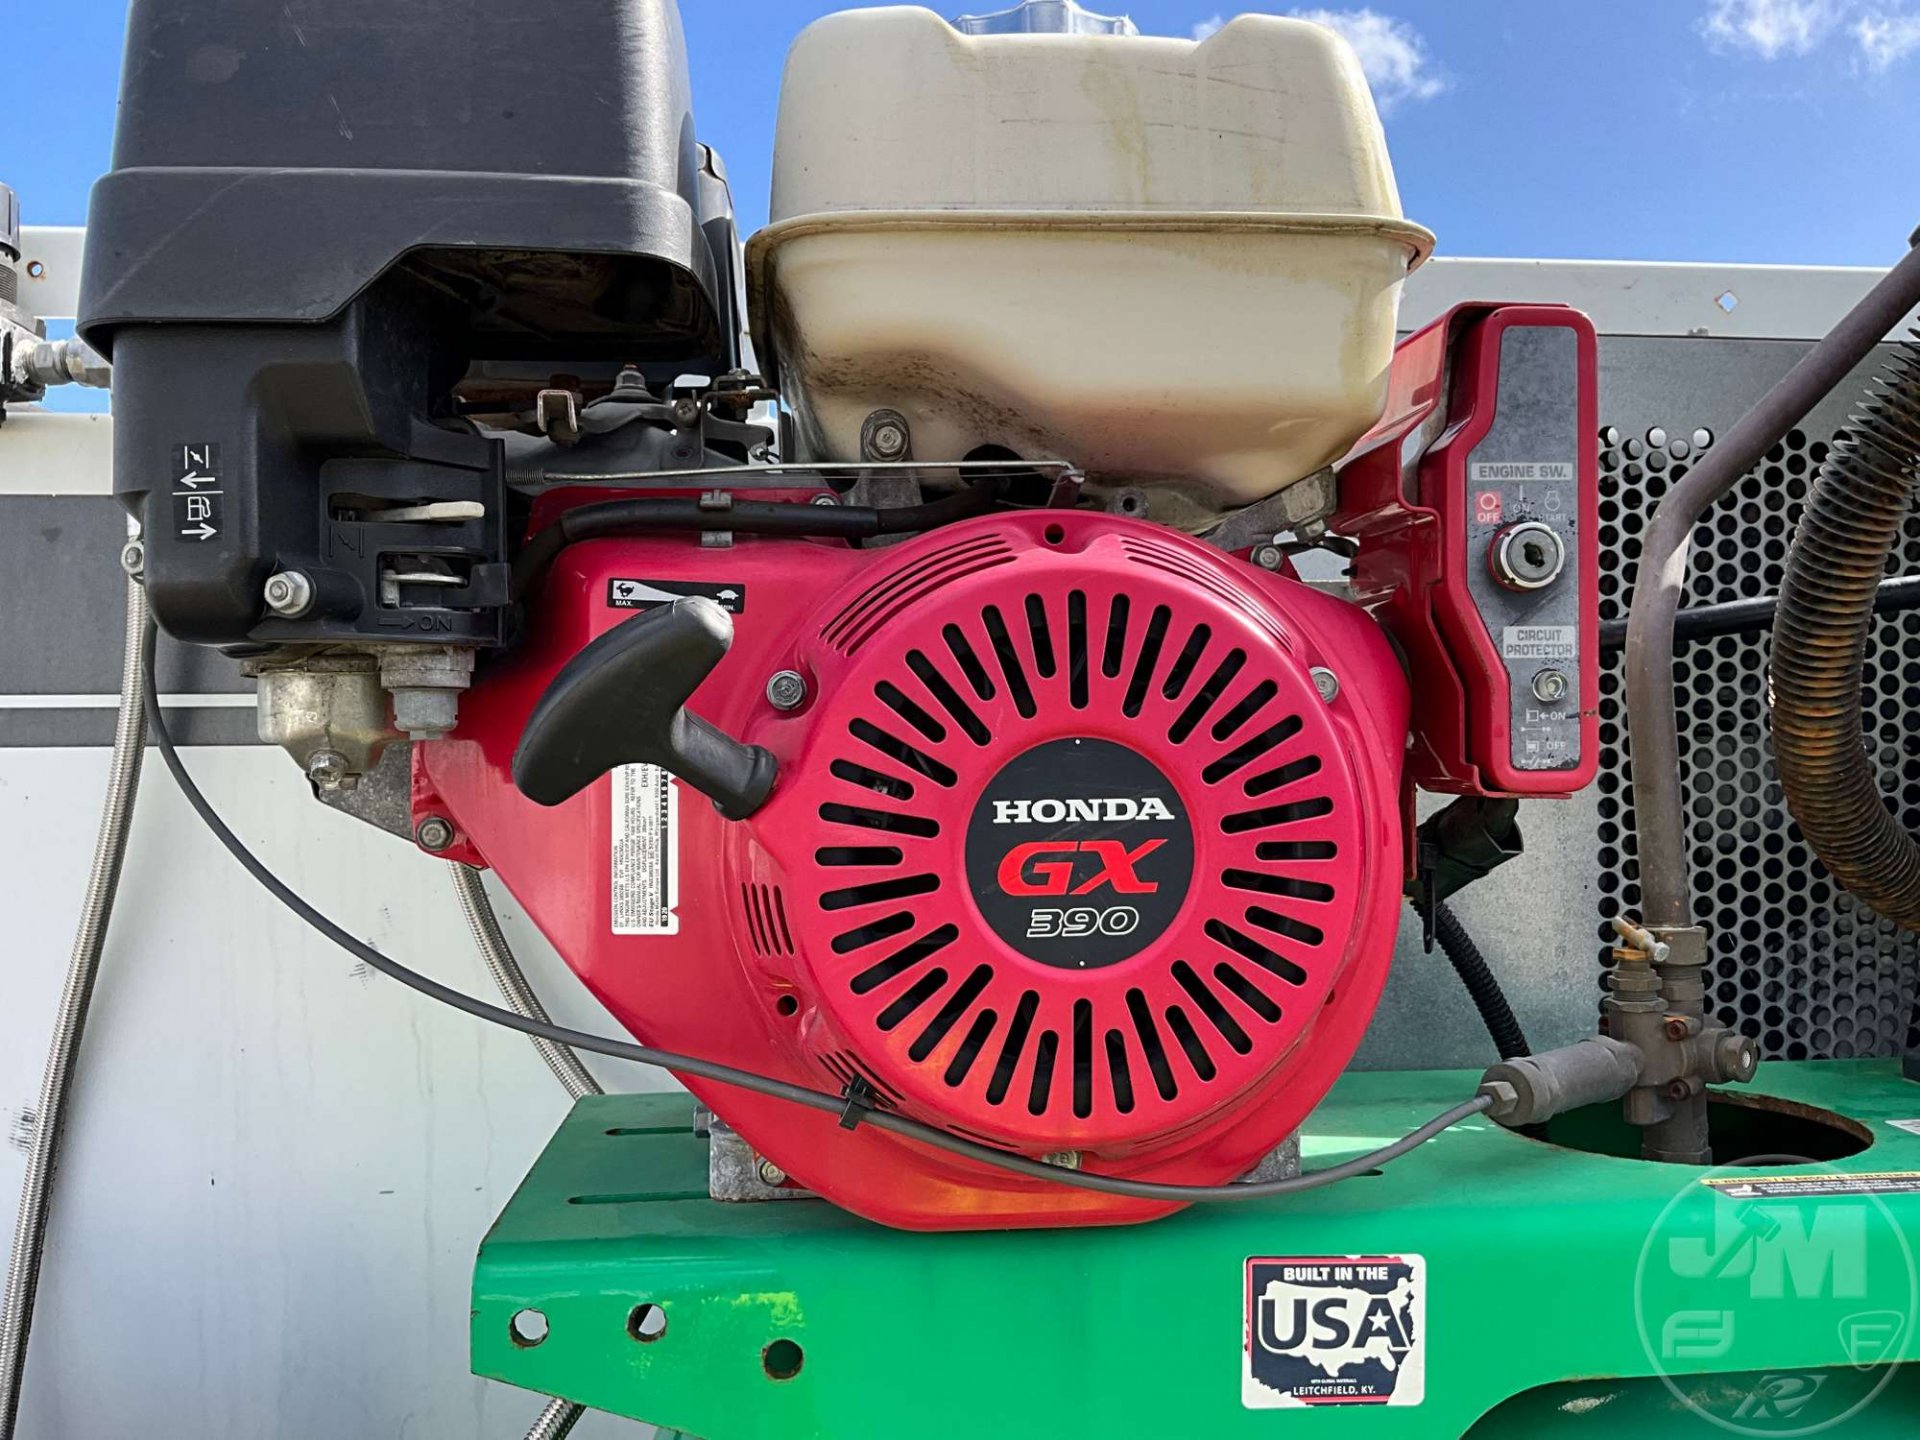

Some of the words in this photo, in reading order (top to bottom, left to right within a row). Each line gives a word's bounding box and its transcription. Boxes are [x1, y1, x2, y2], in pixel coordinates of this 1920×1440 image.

[1479, 465, 1534, 478] ENGINE
[1539, 465, 1567, 478] SW.
[1477, 512, 1500, 522] OFF
[420, 614, 452, 632] ON
[1516, 629, 1562, 641] CIRCUIT
[1506, 644, 1573, 656] PROTECTOR
[1550, 711, 1567, 720] ON
[1546, 741, 1566, 750] OFF
[992, 797, 1175, 824] HONDA
[997, 838, 1169, 897] GX
[1026, 905, 1139, 938] 390
[1283, 1267, 1330, 1281] BUILT
[1335, 1267, 1352, 1281] IN
[1355, 1266, 1388, 1280] THE
[1261, 1297, 1408, 1350] USA
[1293, 1386, 1358, 1396] LEITCHFIELD,
[1361, 1385, 1376, 1394] KY.
